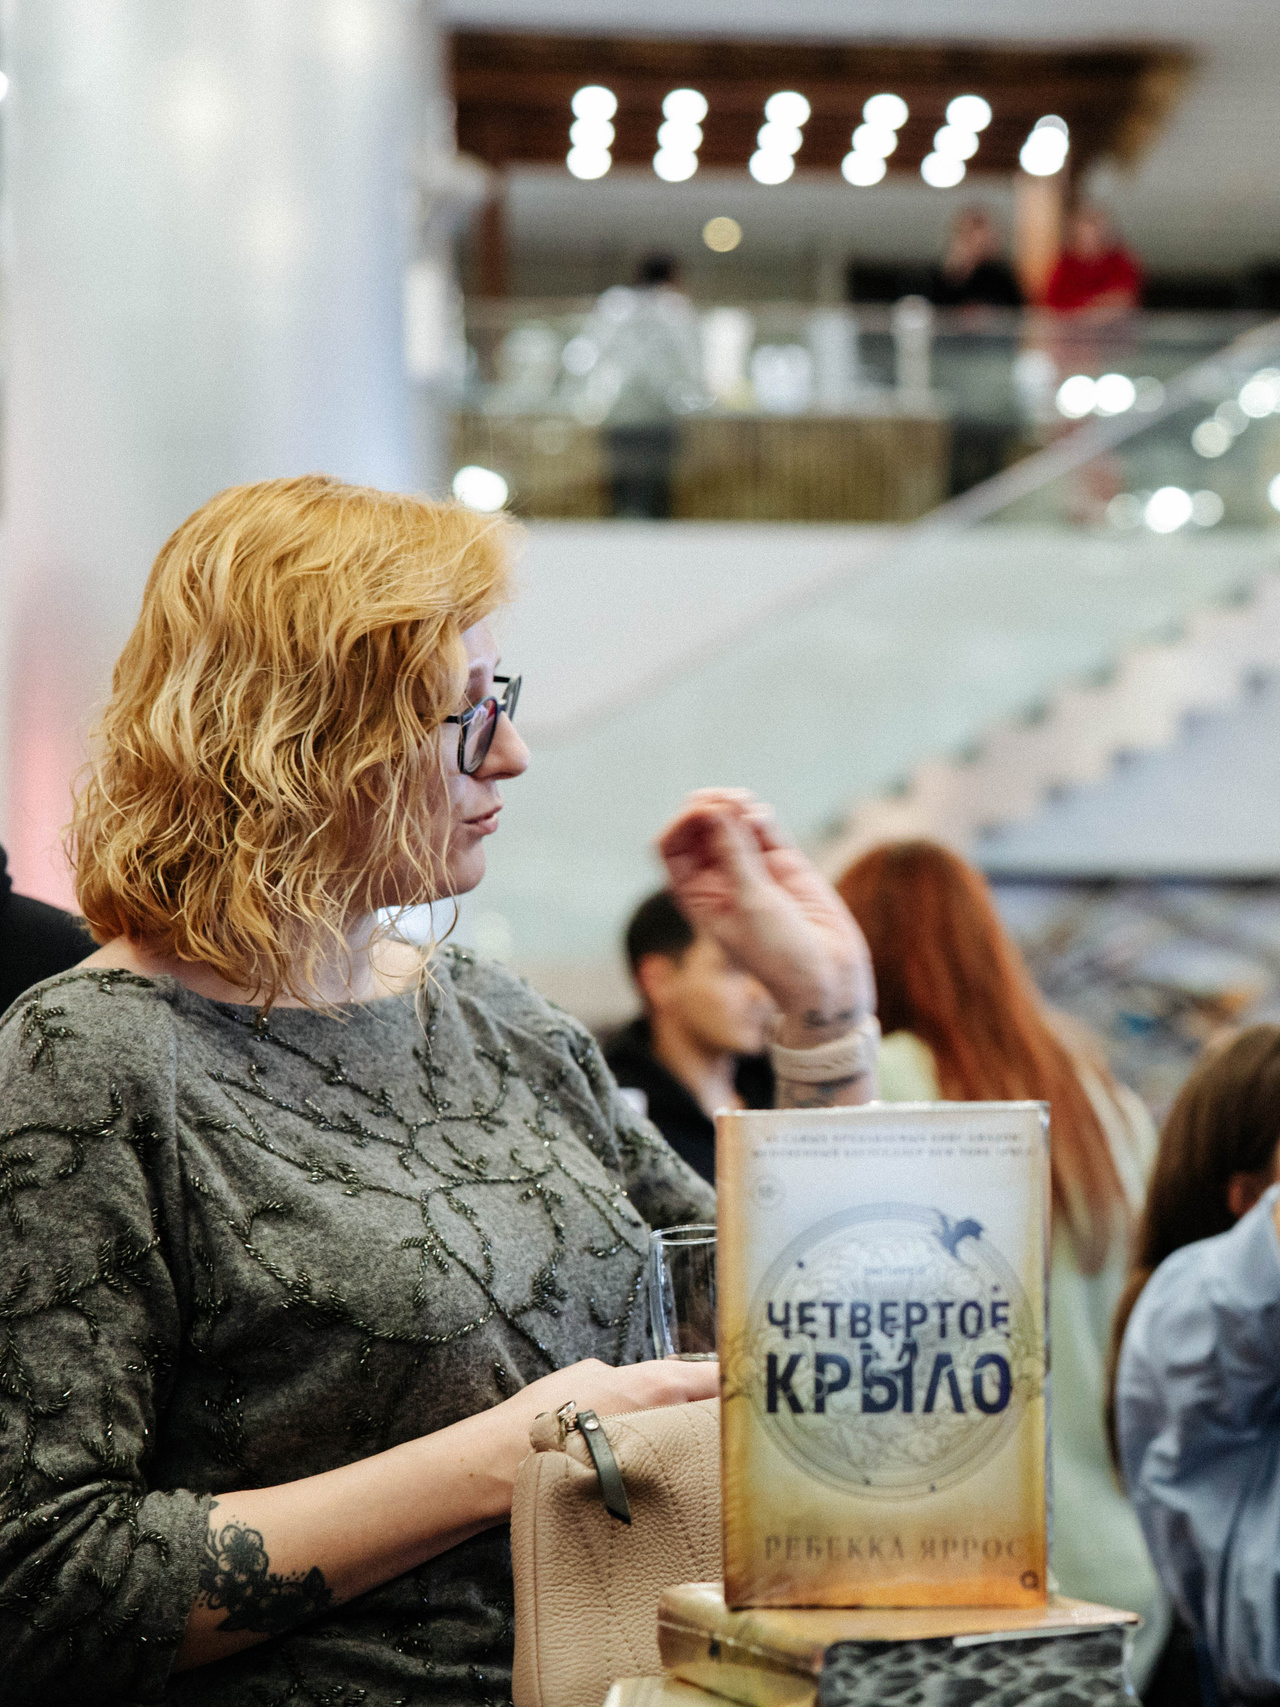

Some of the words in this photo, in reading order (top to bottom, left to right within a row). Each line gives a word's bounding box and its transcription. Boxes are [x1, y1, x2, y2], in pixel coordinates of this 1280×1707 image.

[767, 1300, 1010, 1340] ЧЕТВЕРТОЕ
[766, 1342, 1013, 1414] КРЫЛО
[764, 1534, 905, 1560] РЕБЕККА
[920, 1536, 1020, 1561] ЯРРОС
